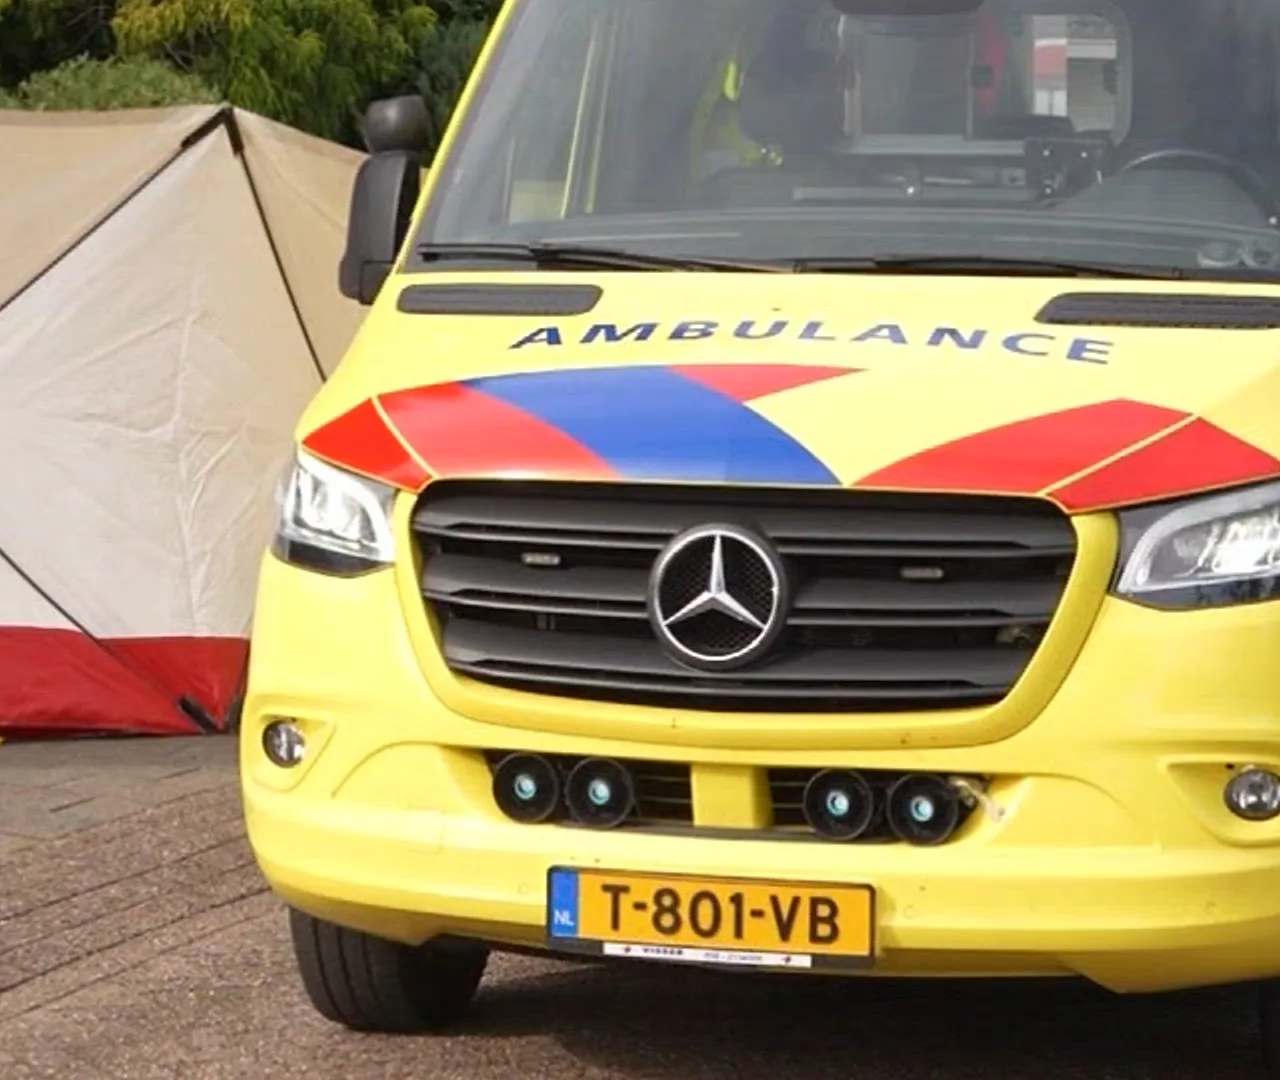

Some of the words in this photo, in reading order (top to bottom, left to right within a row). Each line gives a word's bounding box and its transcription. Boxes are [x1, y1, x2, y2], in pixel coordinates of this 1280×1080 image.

[507, 319, 1115, 365] AMBULANCE
[553, 910, 575, 926] NL
[601, 883, 841, 945] T-801-VB
